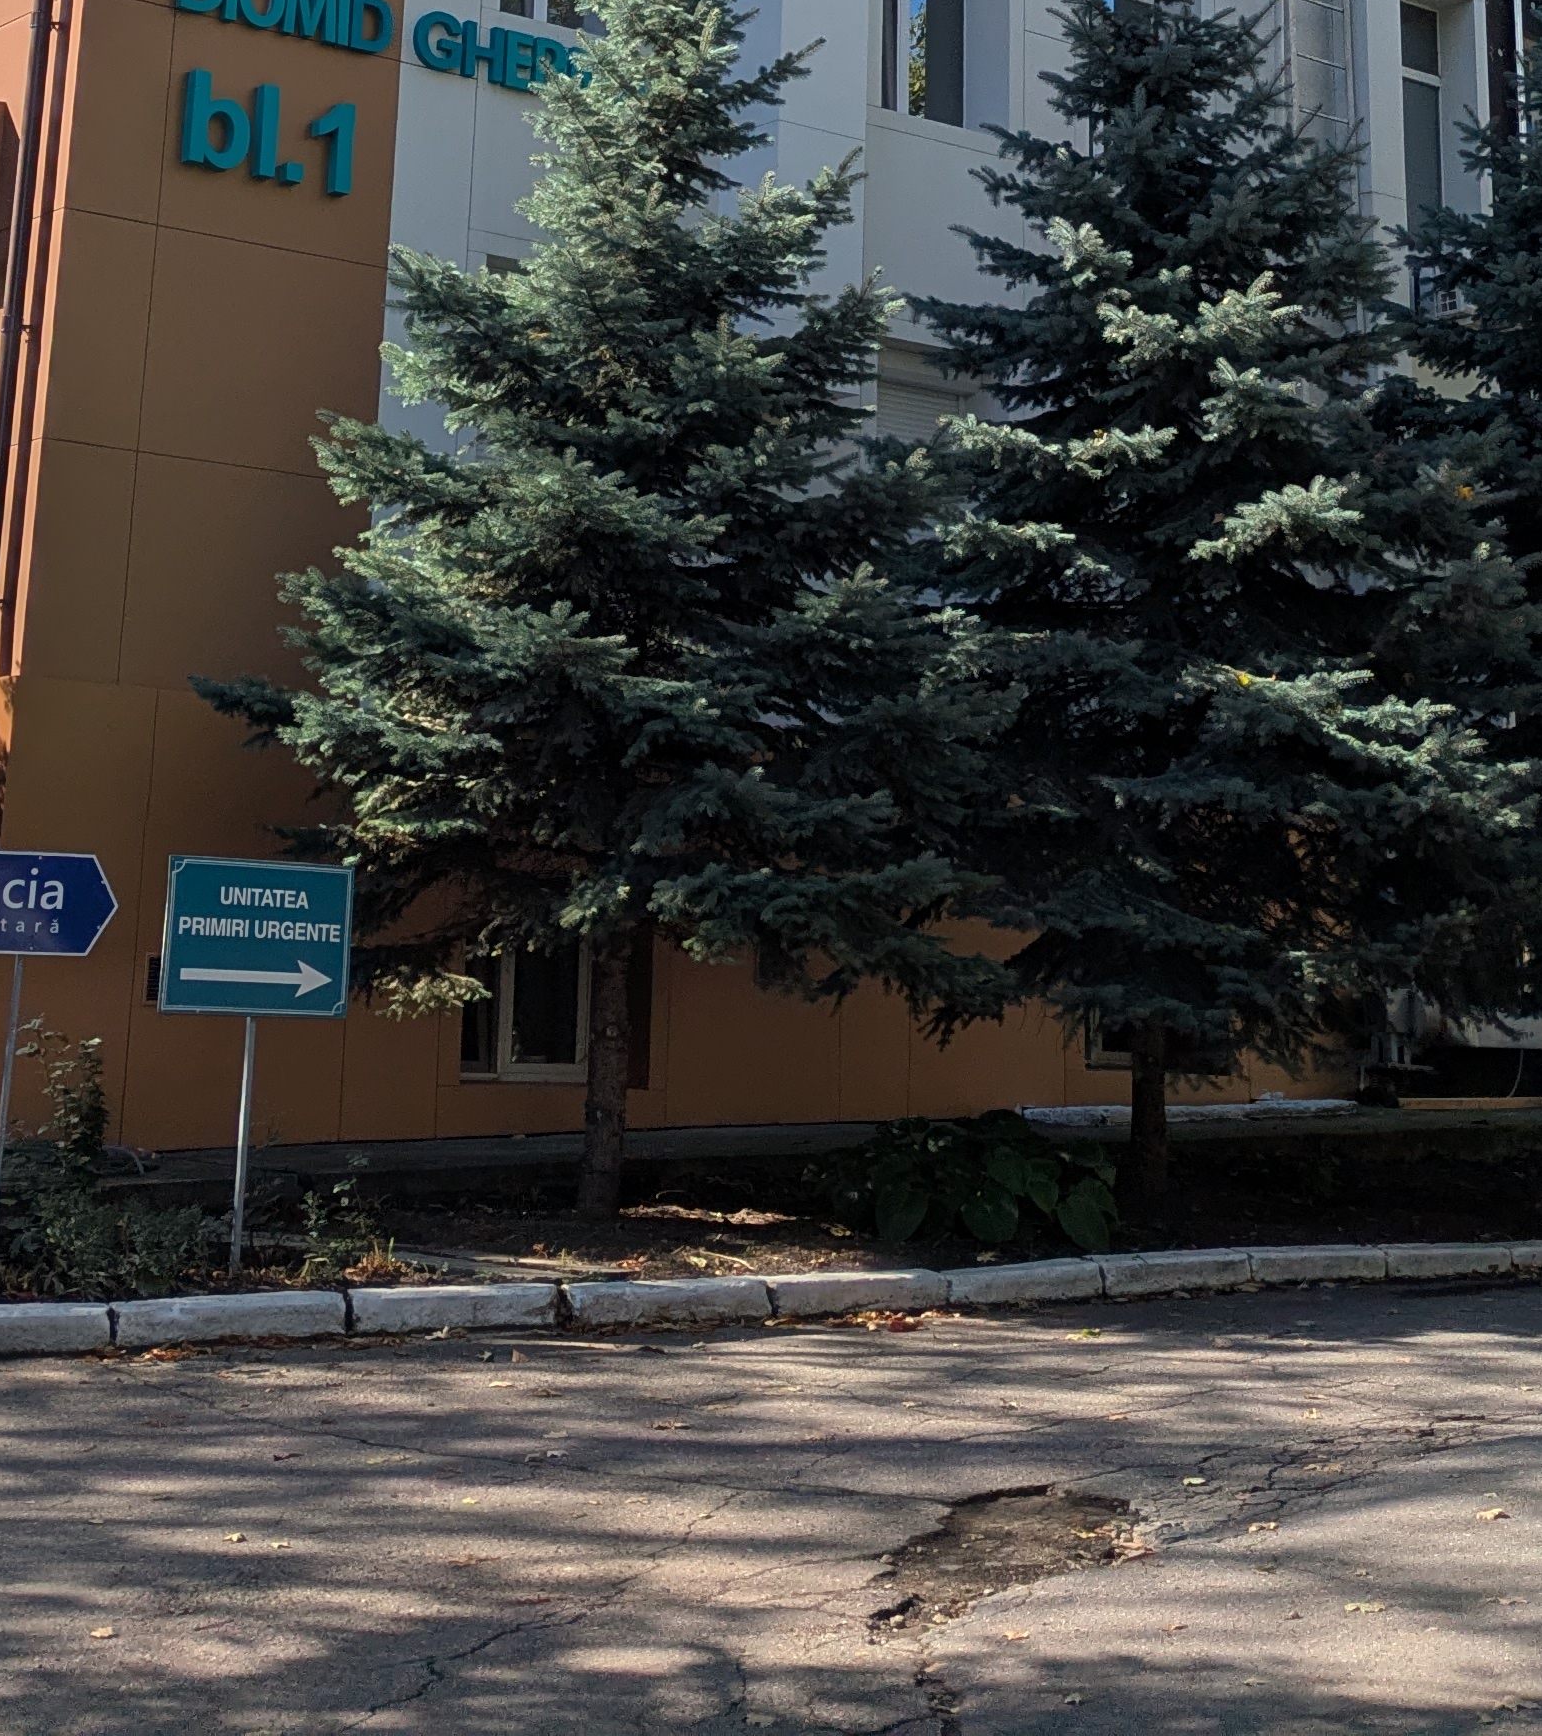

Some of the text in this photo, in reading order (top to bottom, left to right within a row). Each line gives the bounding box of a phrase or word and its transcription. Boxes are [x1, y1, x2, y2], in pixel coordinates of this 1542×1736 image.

[181, 68, 356, 197] bl.1
[220, 886, 309, 910] UNITATEA
[178, 916, 341, 943] PRIMIRI URGENTE
